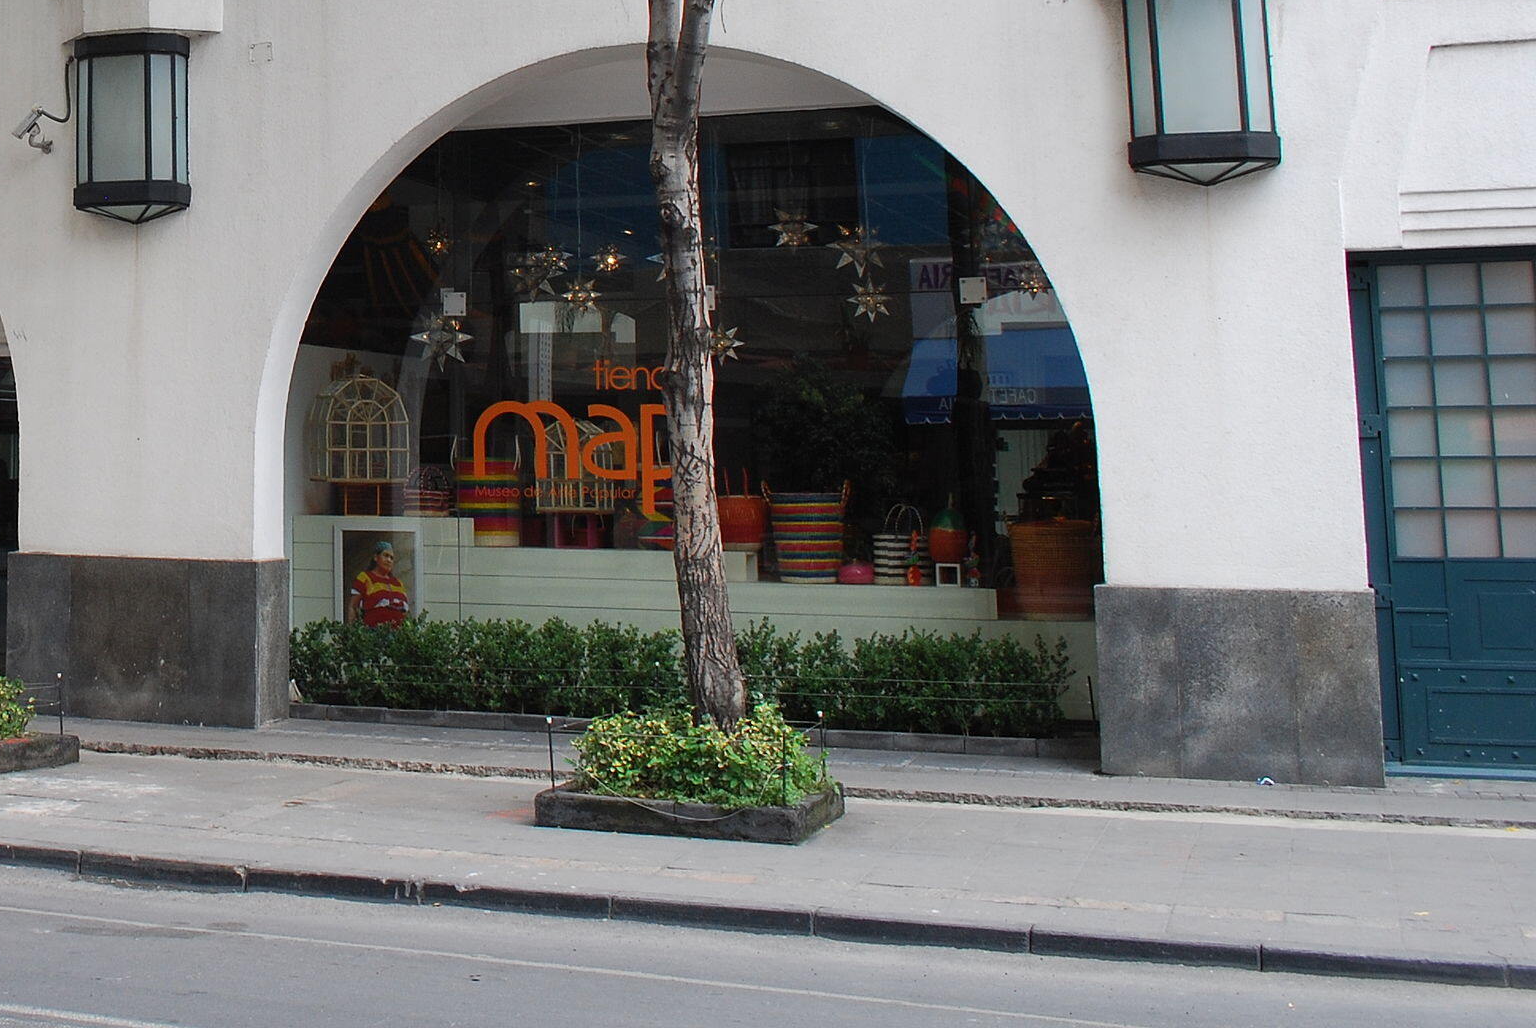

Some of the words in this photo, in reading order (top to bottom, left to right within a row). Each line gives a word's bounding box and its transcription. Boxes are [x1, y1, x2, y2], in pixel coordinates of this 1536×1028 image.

[475, 486, 520, 499] Museo
[524, 486, 542, 499] de
[549, 486, 576, 499] Arte
[582, 486, 636, 500] Popular
